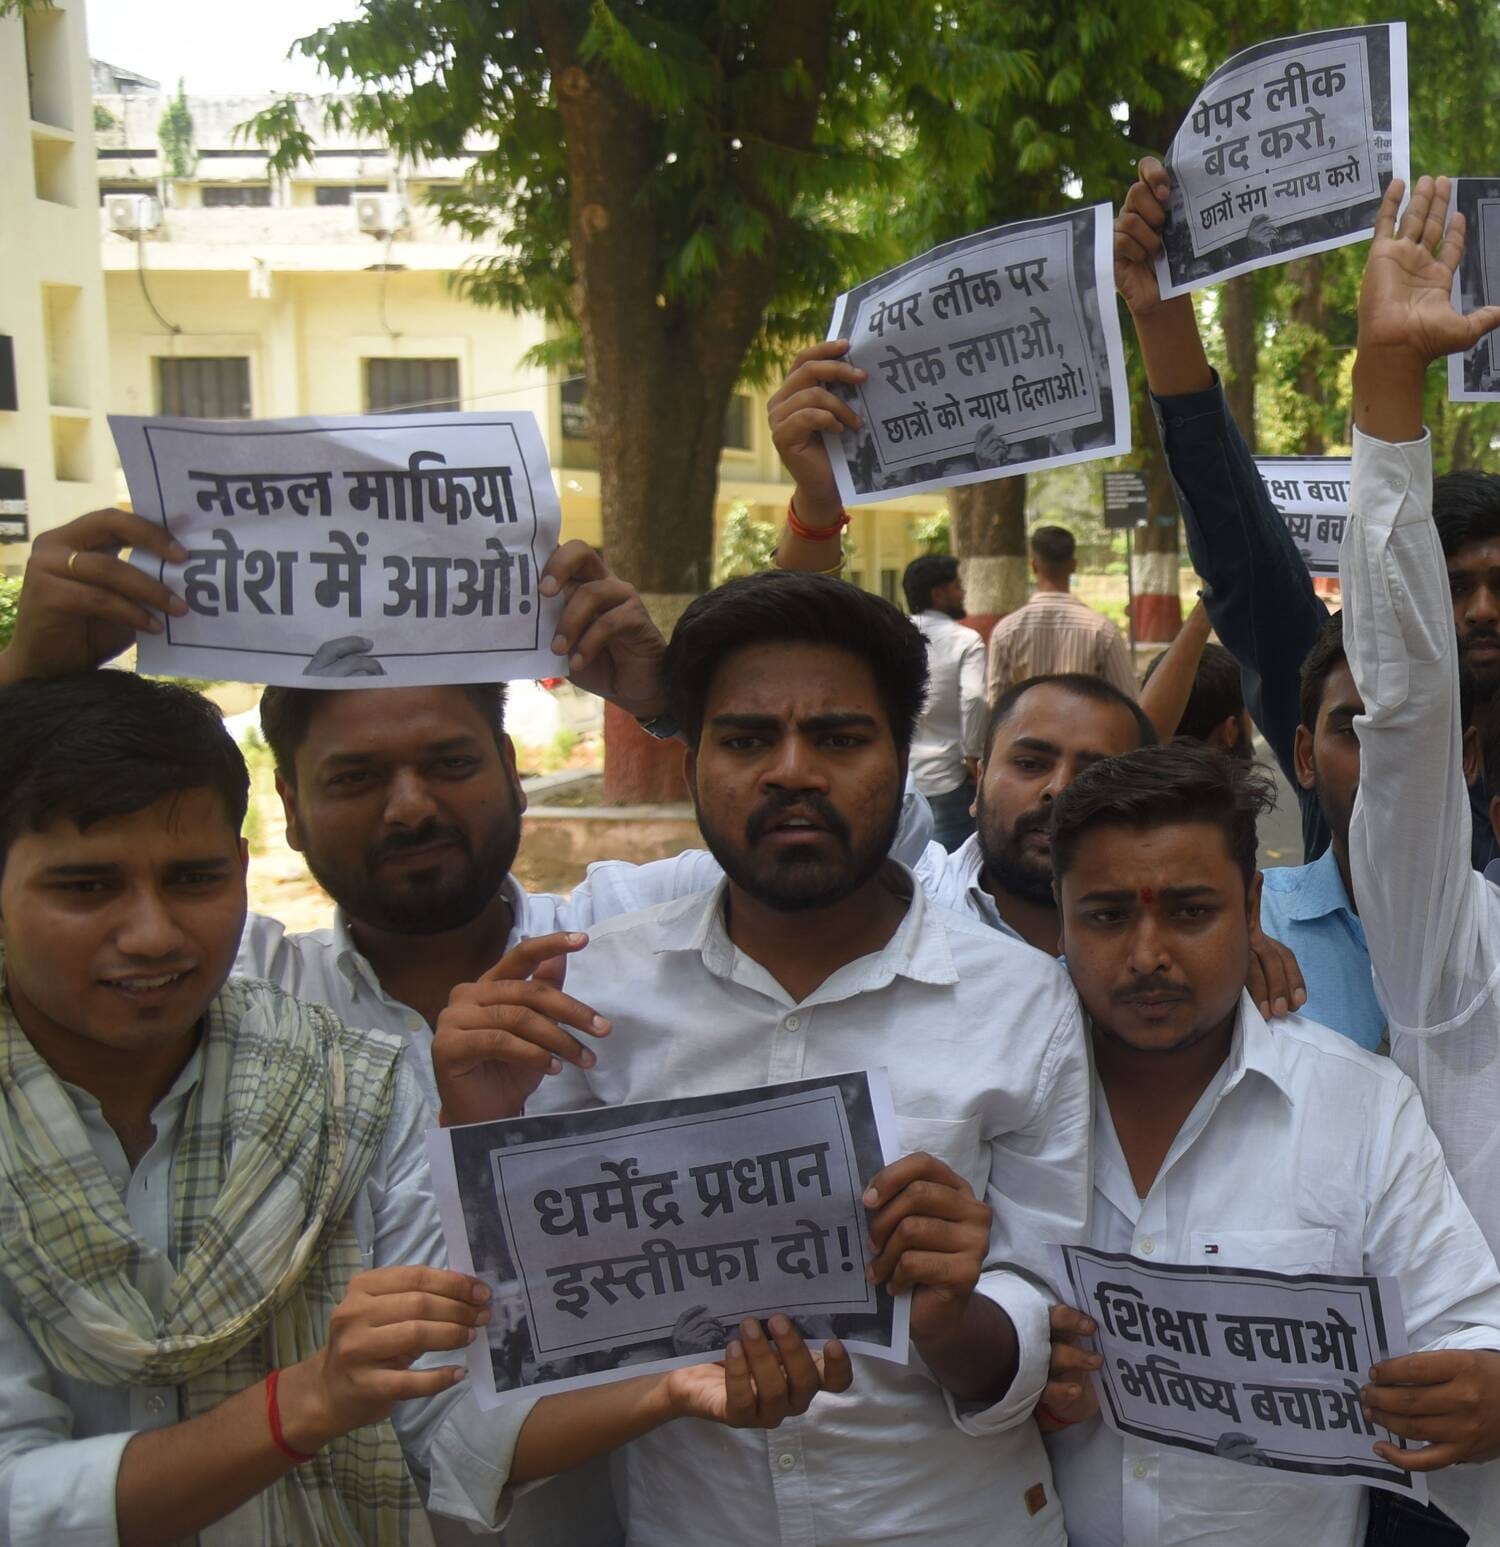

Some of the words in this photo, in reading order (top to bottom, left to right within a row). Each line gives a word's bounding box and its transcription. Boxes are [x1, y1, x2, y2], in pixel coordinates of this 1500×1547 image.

[1192, 89, 1254, 138] पेपर
[1264, 62, 1346, 112] लीक
[1202, 134, 1250, 176] बंद
[1258, 107, 1336, 159] करो,
[1200, 191, 1234, 230] छात्रों
[1236, 184, 1268, 213] संग
[1272, 171, 1321, 199] न्याय
[1326, 155, 1361, 189] करो
[869, 292, 923, 337] पेपर
[929, 268, 1001, 320] लीक
[1005, 257, 1049, 296] पर
[879, 345, 945, 394] रोक
[949, 306, 1064, 377] लगाओ,
[882, 401, 933, 443] छात्रों
[934, 393, 961, 430] को
[964, 386, 1011, 422] न्याय
[1012, 364, 1087, 408] दिलाओ!
[188, 470, 332, 517] नकल
[342, 451, 518, 525] माफिया
[1303, 480, 1351, 502] बचा
[183, 529, 298, 617] होश
[310, 530, 369, 618] में
[382, 538, 532, 618] आओ!
[533, 1157, 685, 1238] धर्मेंद्र
[690, 1142, 832, 1219] प्रधान
[546, 1238, 761, 1320] इस्तीफा
[771, 1219, 854, 1280] दो!
[1094, 1281, 1211, 1357] शिक्षा
[1215, 1307, 1359, 1372] बचाओ
[1117, 1353, 1242, 1424] भविष्य
[1243, 1379, 1376, 1436] बचाओ
